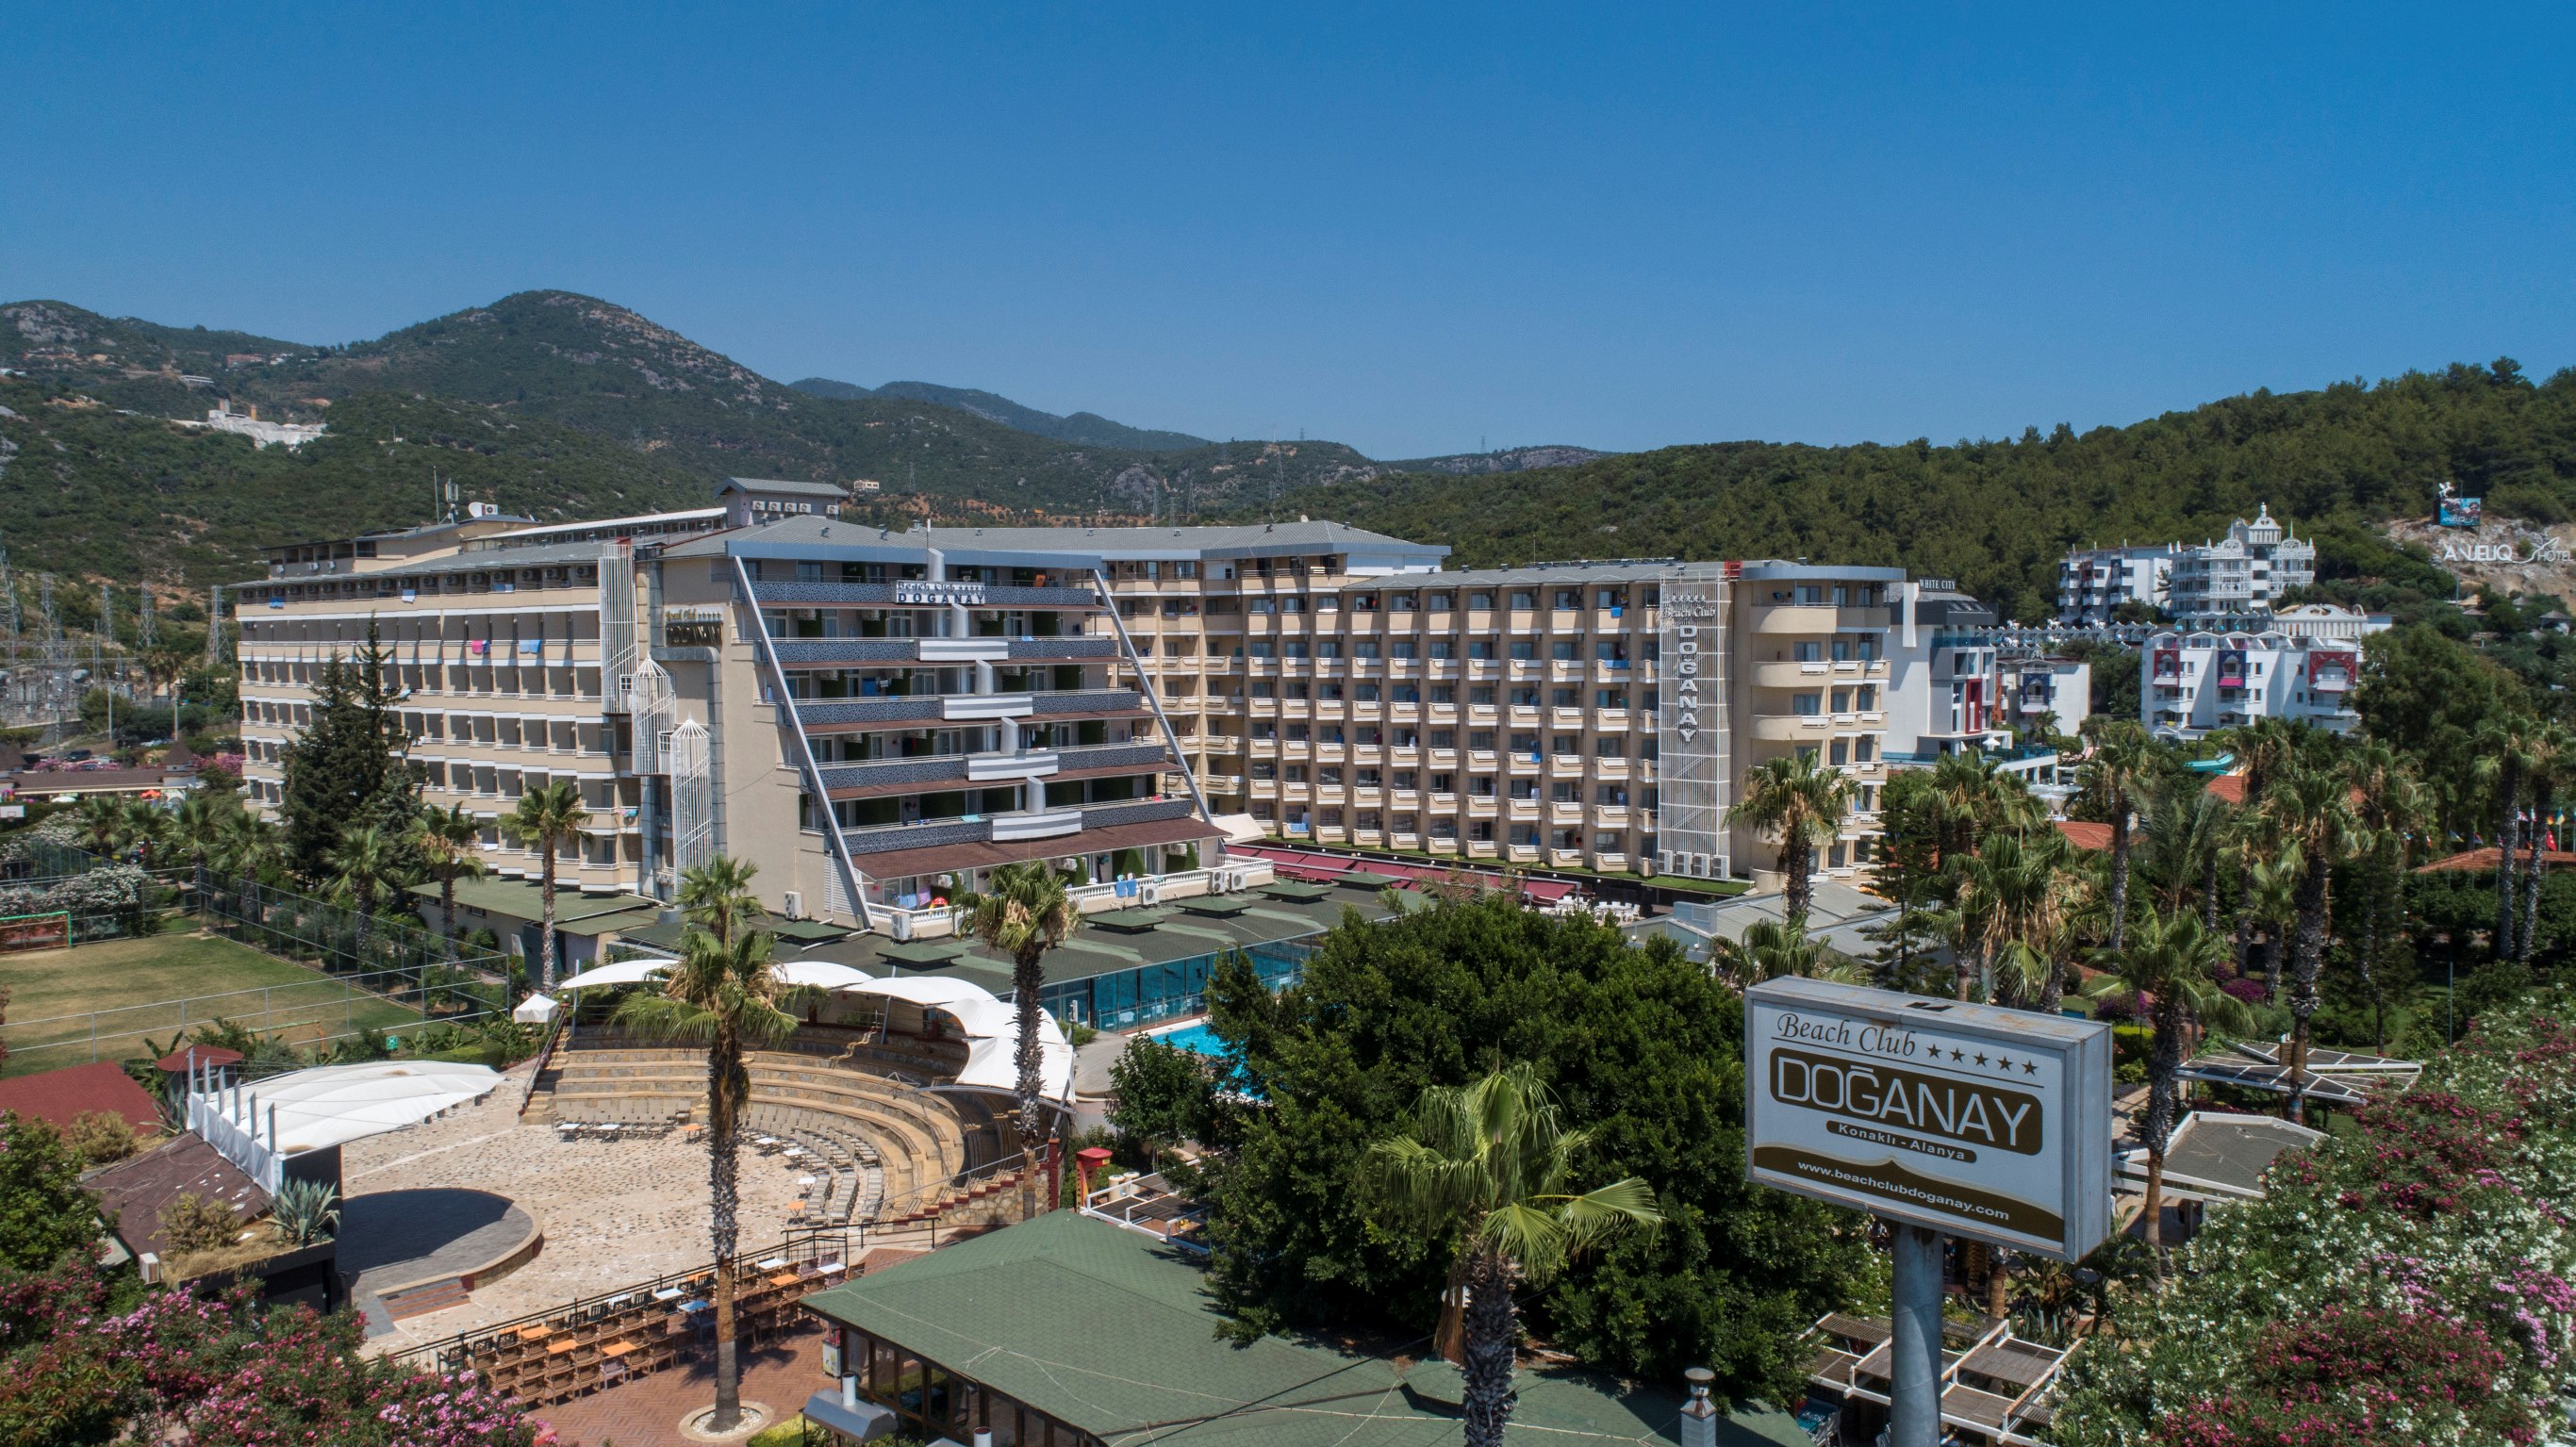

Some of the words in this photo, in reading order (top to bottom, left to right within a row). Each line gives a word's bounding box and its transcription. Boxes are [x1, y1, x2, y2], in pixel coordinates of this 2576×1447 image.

[2537, 550, 2573, 563] HOTEL
[1919, 579, 1940, 589] WHITE
[1941, 580, 1956, 590] CITY
[1777, 1012, 1851, 1044] Beach
[1858, 1024, 1916, 1057] Club
[1909, 1140, 1965, 1160] Alanya
[1797, 1160, 2010, 1221] www.beachclubdoganay.com
